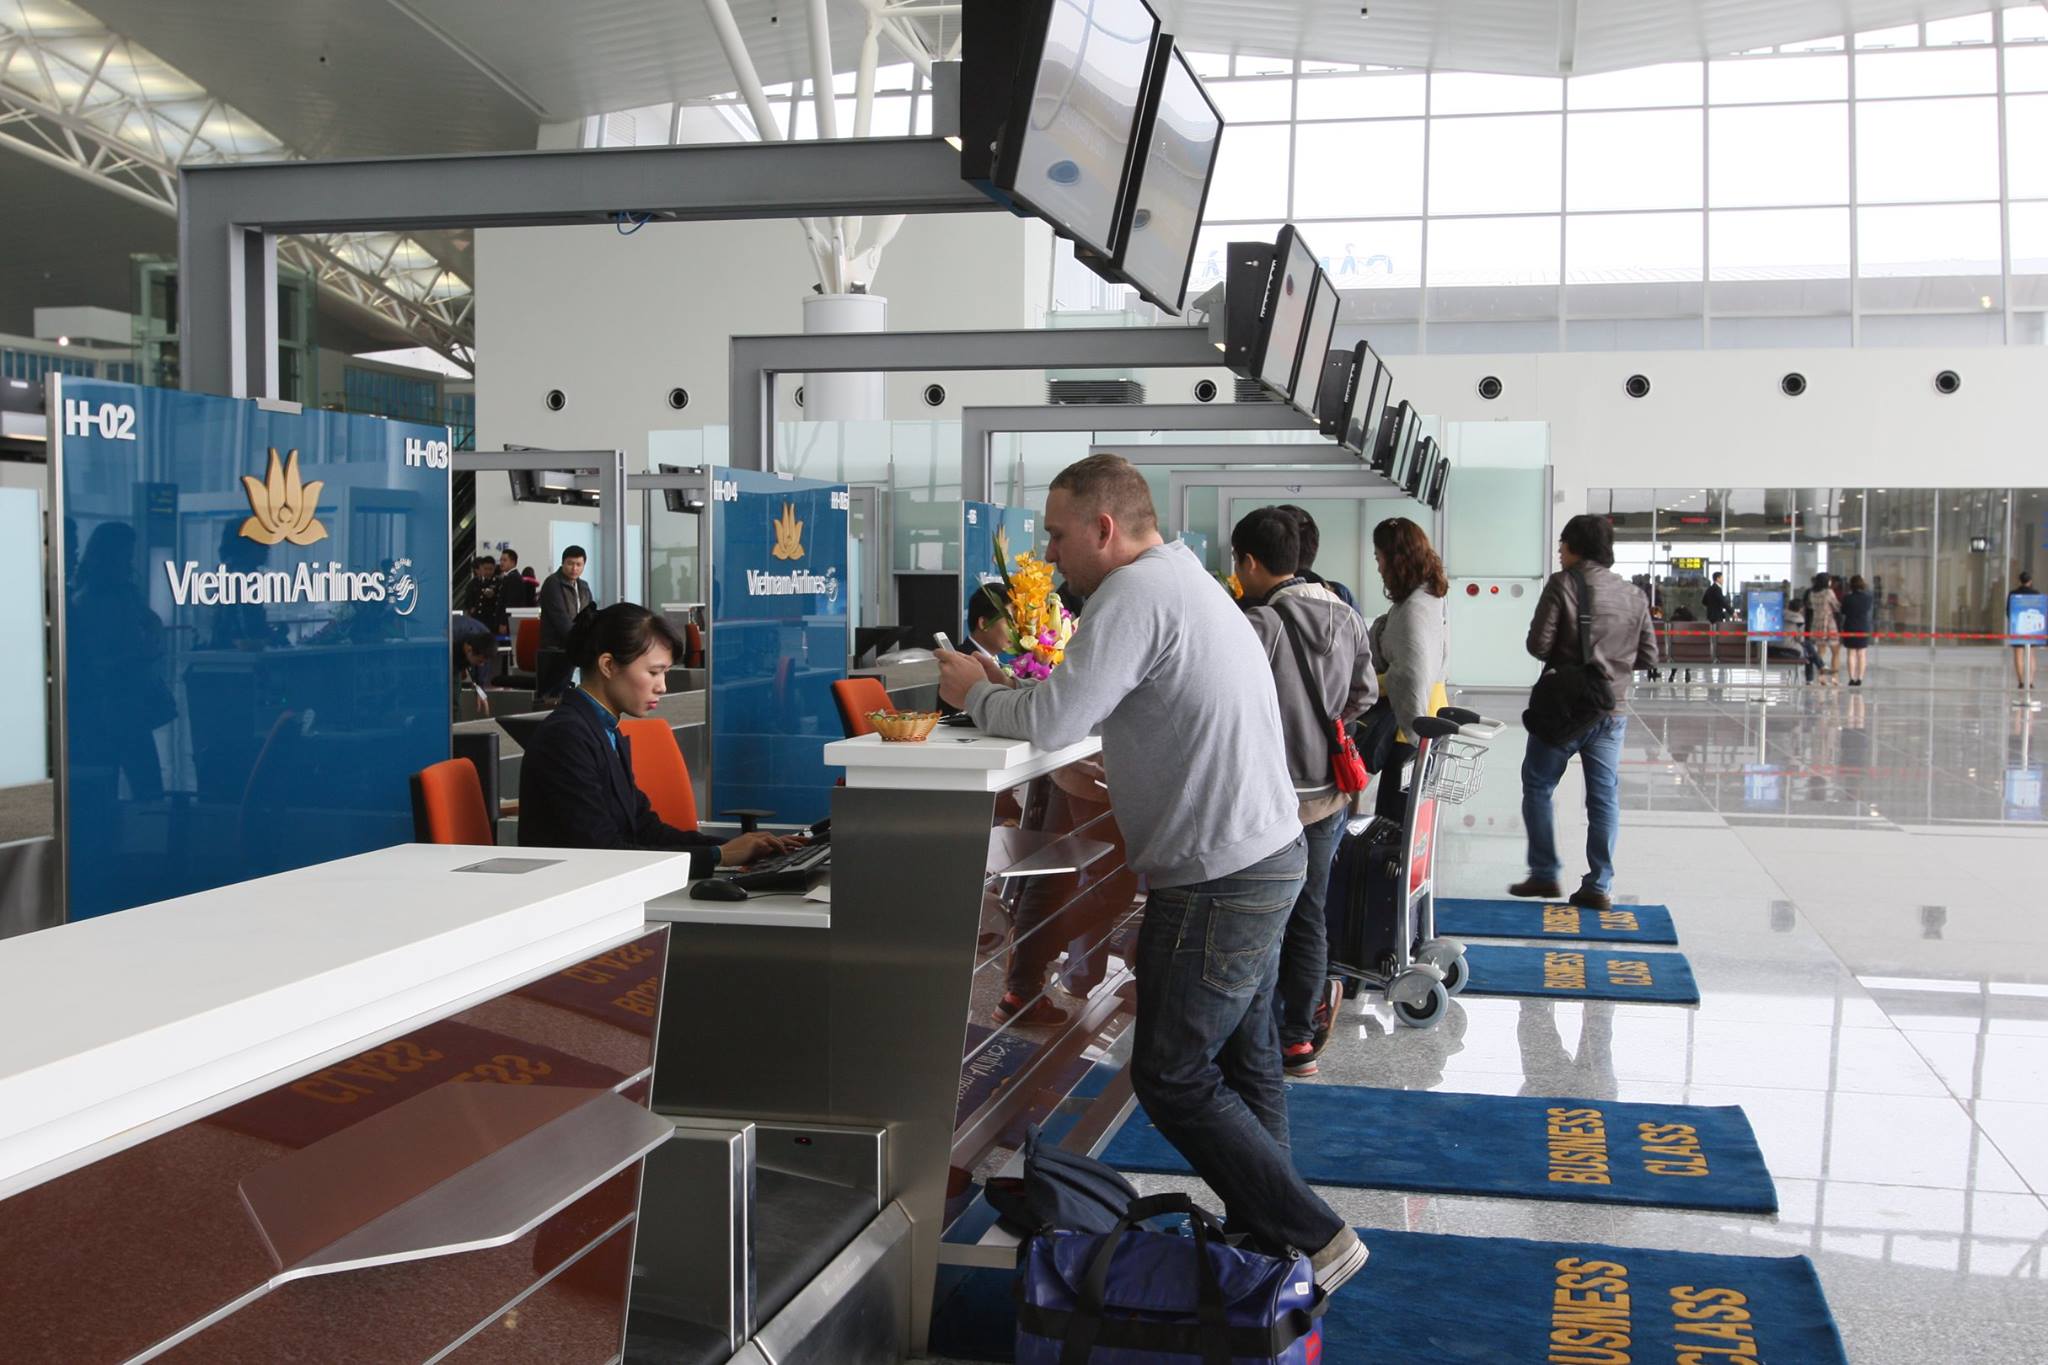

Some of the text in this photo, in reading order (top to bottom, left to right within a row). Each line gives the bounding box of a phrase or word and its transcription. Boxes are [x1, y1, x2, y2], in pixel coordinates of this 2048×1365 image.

[65, 399, 136, 440] H-02
[405, 437, 449, 469] H-03
[713, 479, 738, 502] H-04
[1543, 951, 1586, 989] BUSINESS
[1606, 960, 1653, 986] CLASS
[1546, 1107, 1612, 1185] BUSINESS
[1638, 1122, 1709, 1177] CLASS
[1548, 1257, 1632, 1365] USINESS
